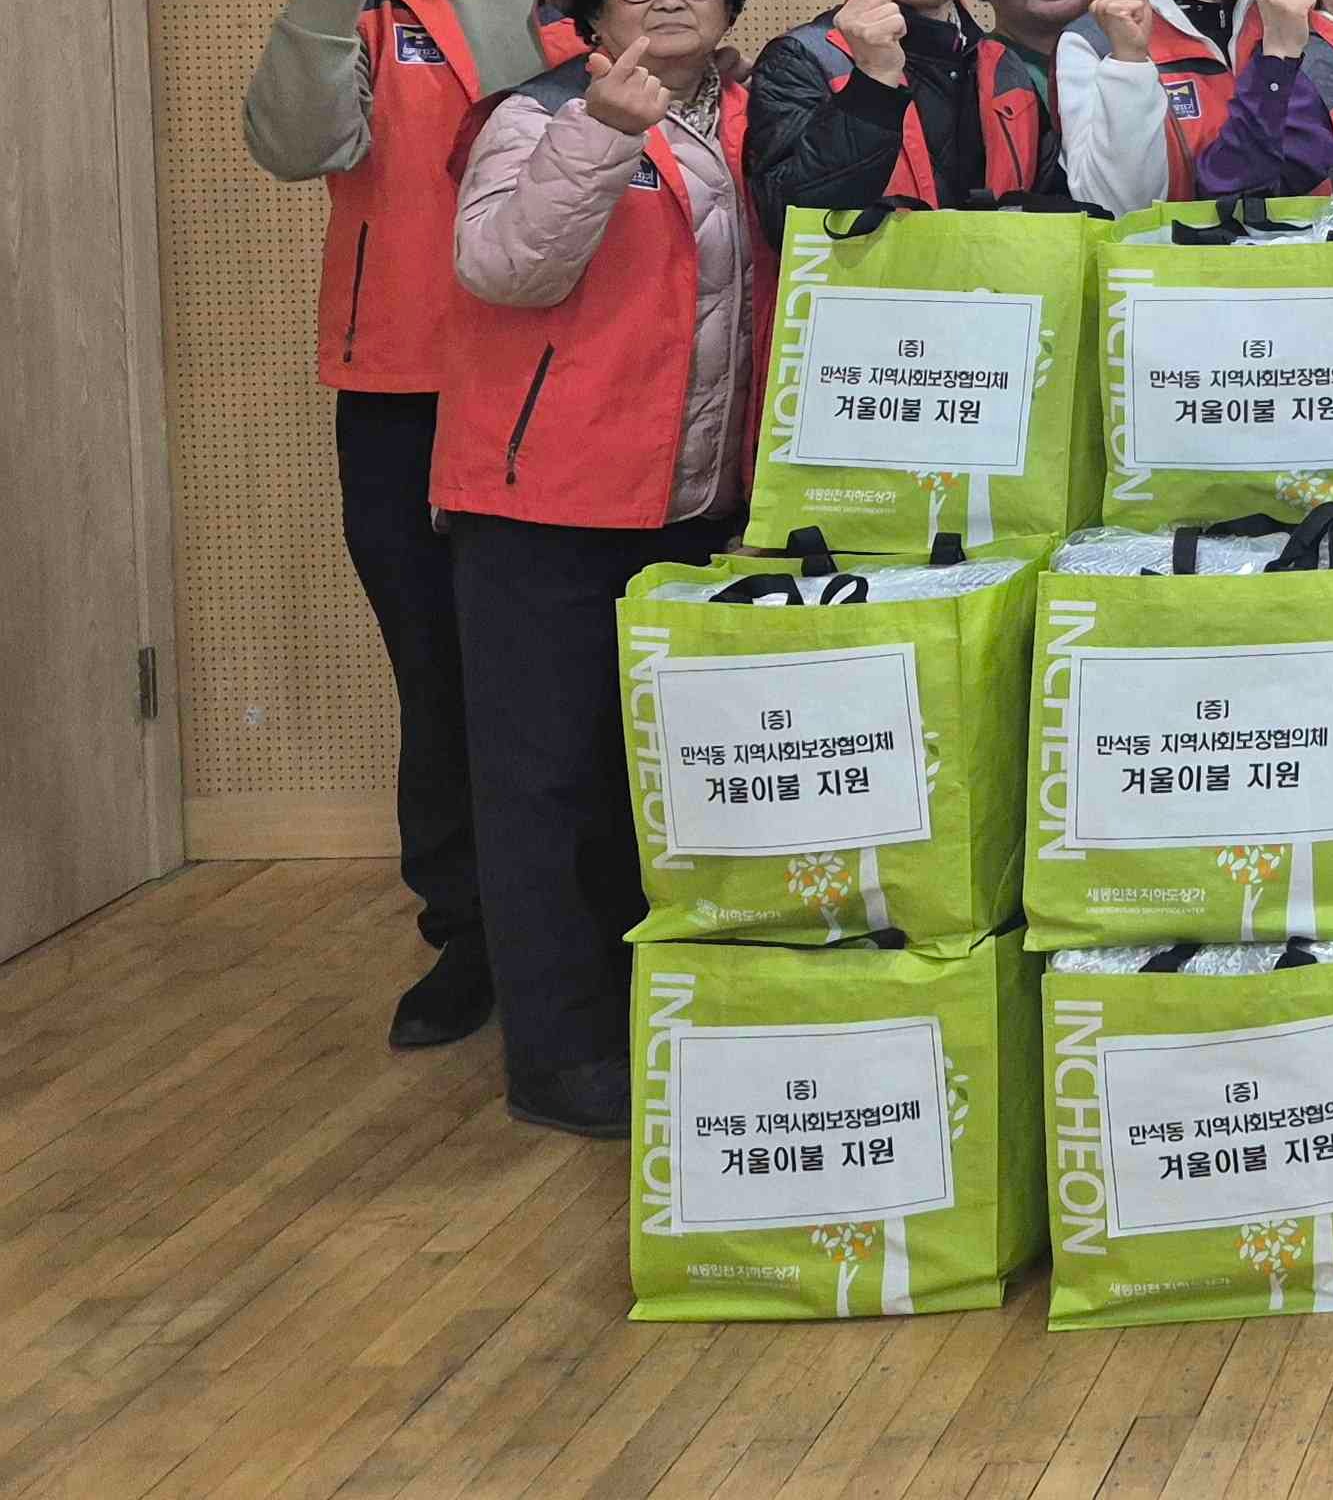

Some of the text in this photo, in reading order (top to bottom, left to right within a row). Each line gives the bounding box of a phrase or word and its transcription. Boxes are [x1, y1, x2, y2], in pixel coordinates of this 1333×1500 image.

[820, 366, 1008, 390] 만석동 지역사회보장협의체
[1150, 371, 1200, 389] 만석동
[834, 396, 980, 424] 겨울이불 지원
[1175, 399, 1275, 424] 겨울이불
[680, 731, 893, 766] 만석동 지역사회보장협의체
[1096, 728, 1327, 755] 만석동 지역사회보장협의체
[705, 767, 870, 804] 겨울이불 지원
[1121, 762, 1300, 794] 겨울이불 지원
[696, 1100, 920, 1137] 만석동 지역사회보장협의체
[1054, 1000, 1107, 1255] INCHEON
[1129, 1122, 1184, 1146] 만석동
[721, 1137, 894, 1175] 겨울이불 지원
[1159, 1144, 1267, 1181] 겨울이불
